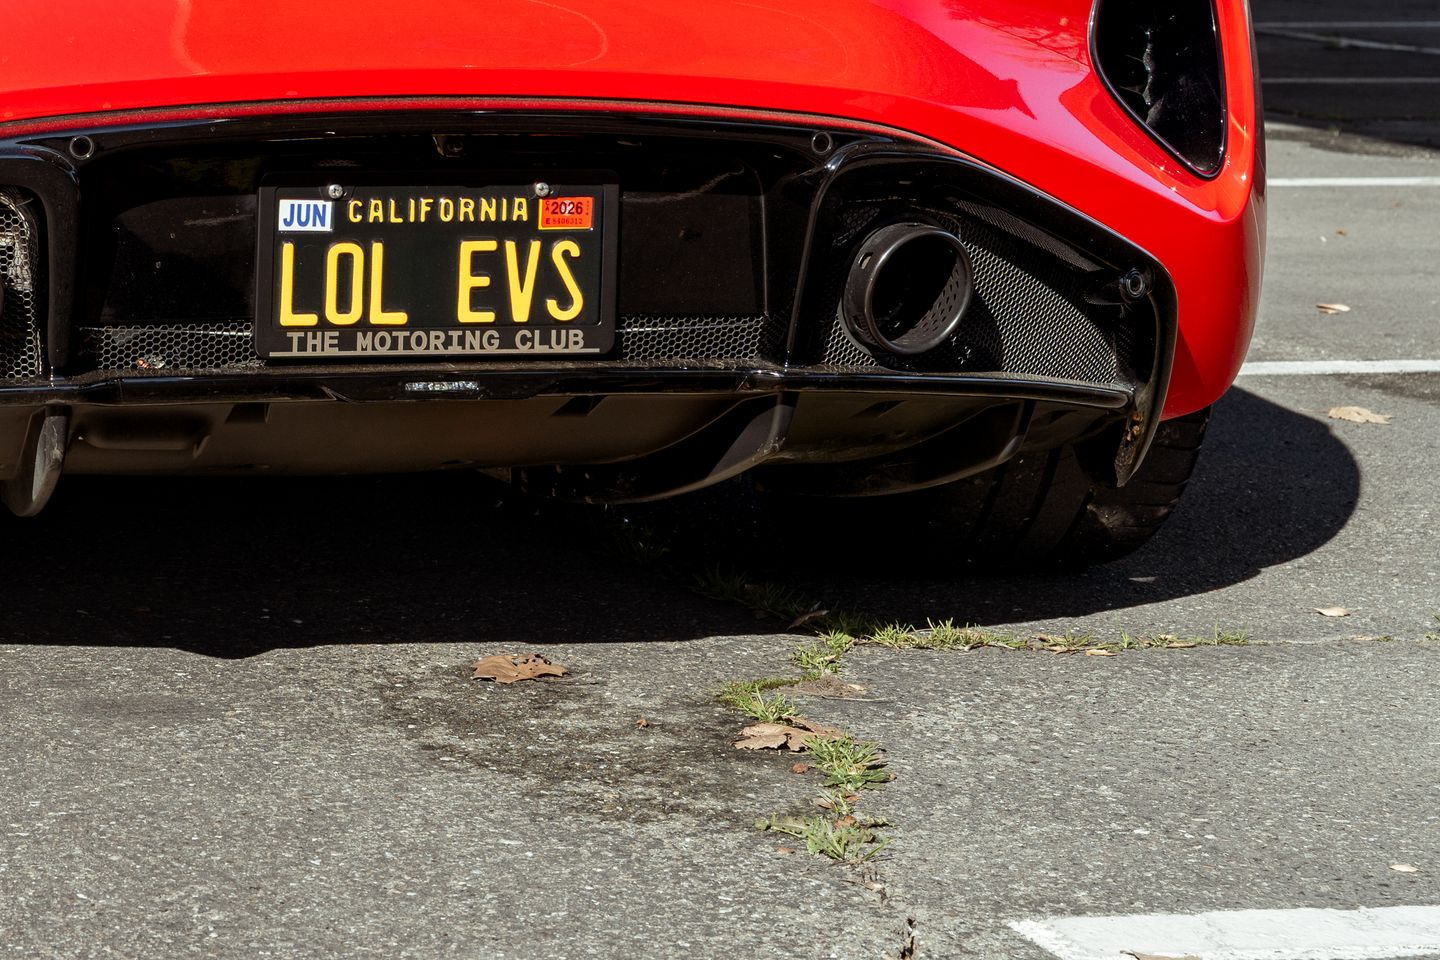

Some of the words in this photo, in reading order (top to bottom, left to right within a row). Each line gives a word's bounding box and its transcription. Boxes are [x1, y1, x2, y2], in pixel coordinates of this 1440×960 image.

[281, 203, 327, 228] JUN
[348, 197, 529, 224] CALIFORNIA
[550, 201, 583, 215] 2026
[279, 241, 408, 327] LOL
[457, 240, 584, 323] EVS
[286, 331, 340, 352] THE
[356, 330, 500, 352] MOTORING
[514, 329, 585, 350] CLUB
